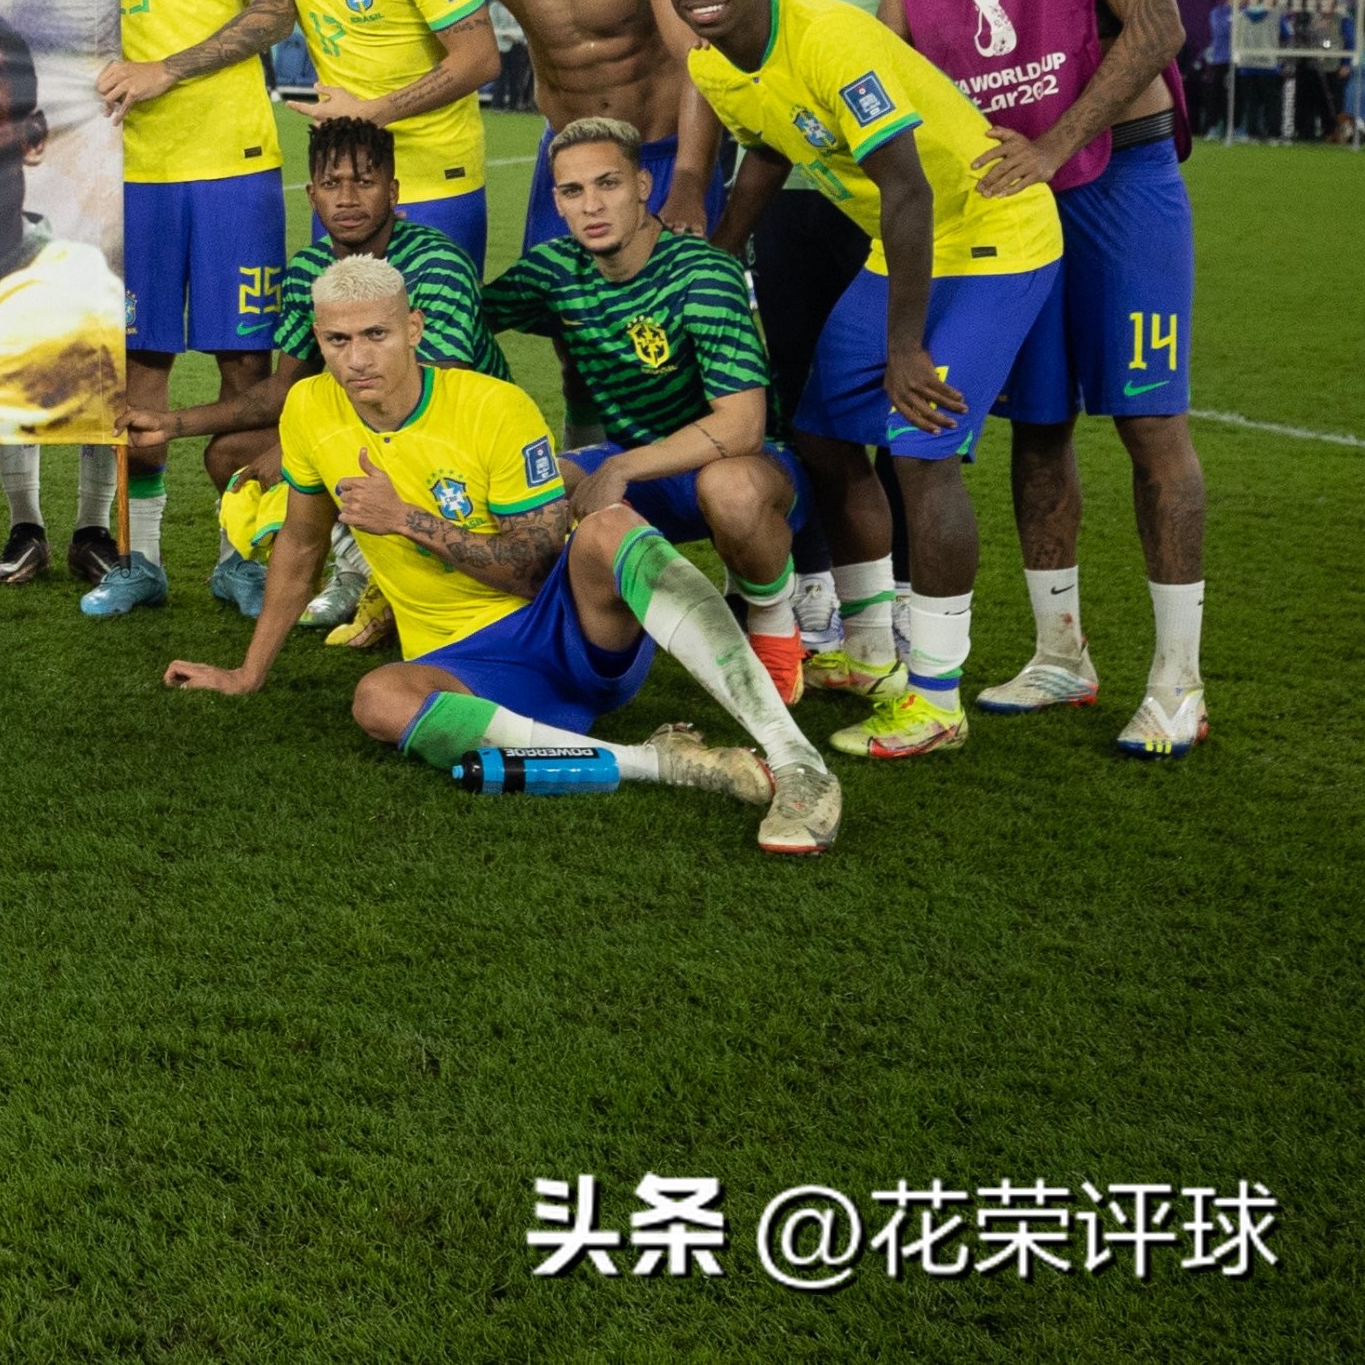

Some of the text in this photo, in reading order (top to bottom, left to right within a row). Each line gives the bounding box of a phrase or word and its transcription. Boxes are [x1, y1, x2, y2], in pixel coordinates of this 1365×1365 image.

[970, 62, 1041, 93] WORLD
[1042, 52, 1066, 72] UP
[239, 266, 281, 314] 25
[1128, 312, 1177, 371] 14
